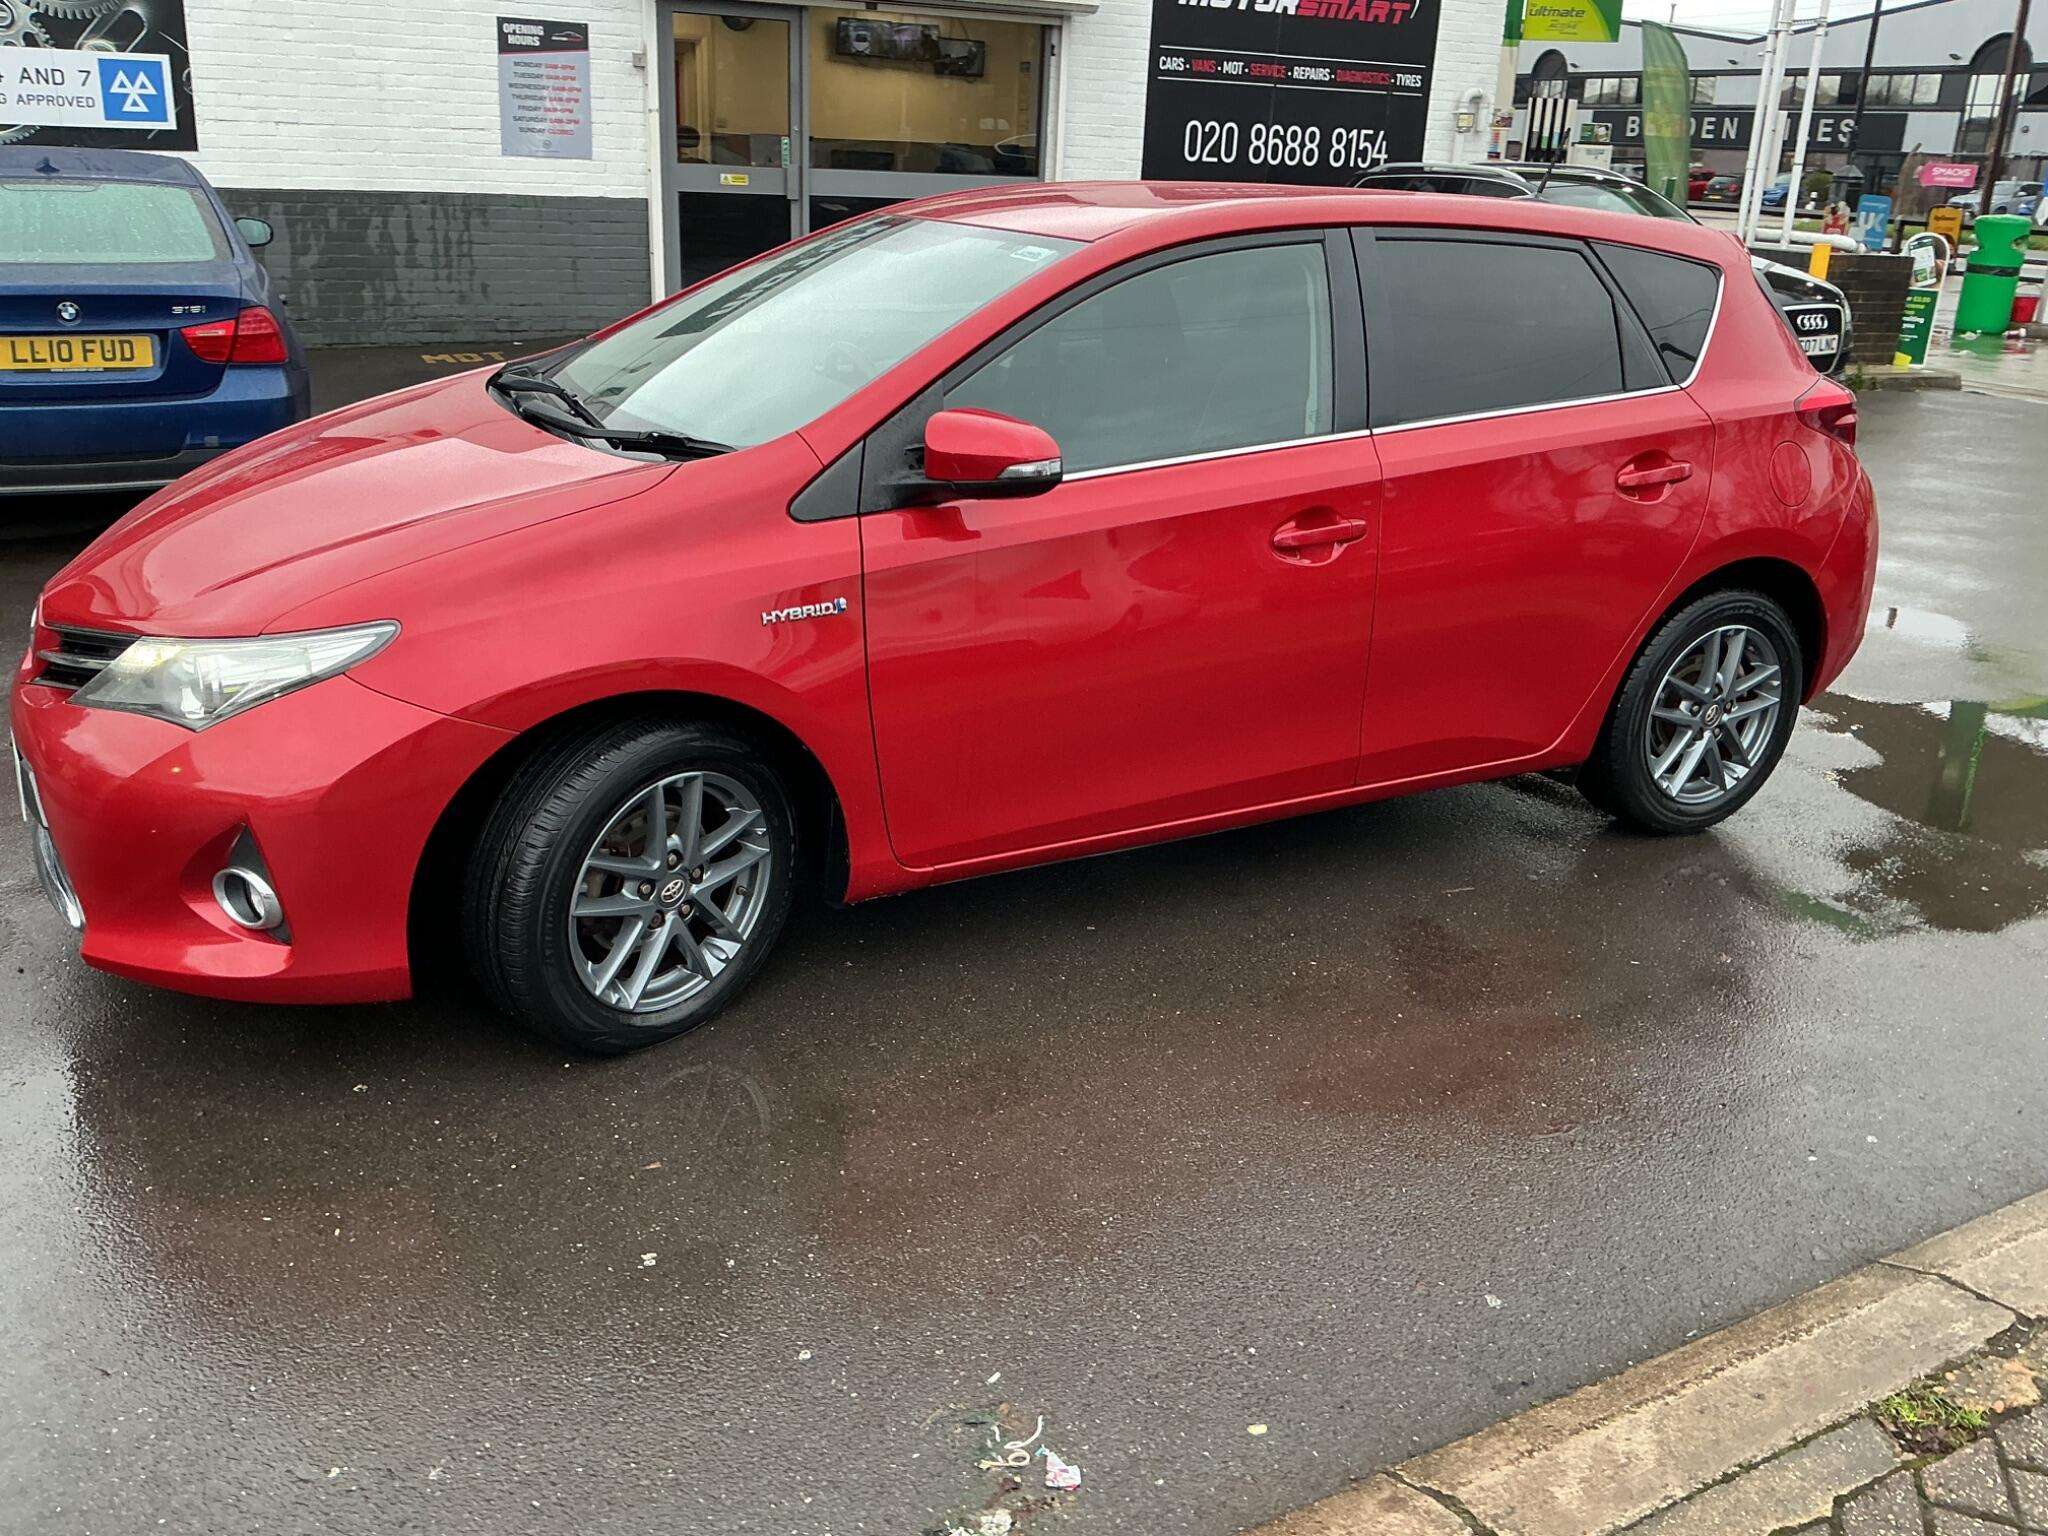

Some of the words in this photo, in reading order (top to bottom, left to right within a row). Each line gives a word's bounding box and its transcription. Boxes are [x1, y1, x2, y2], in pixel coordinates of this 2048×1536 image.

[503, 23, 544, 36] OPENING
[508, 34, 540, 46] HOURS
[19, 67, 65, 86] AND
[78, 70, 92, 87] 7
[1159, 56, 1184, 71] CARS
[1191, 59, 1216, 74] VANS
[1222, 61, 1244, 75] MOT
[1250, 63, 1287, 78] SERVICE
[1293, 66, 1330, 81] REPAIRS
[1336, 69, 1390, 85] DIAGNOSTICS
[1396, 73, 1422, 87] TYRES
[17, 94, 95, 108] APPROVED
[1626, 116, 1738, 139] BEN
[1184, 120, 1239, 163] 020
[1249, 123, 1320, 166] 8688
[1329, 127, 1388, 168] 8154
[10, 340, 72, 363] LL10
[82, 339, 135, 363] FUD
[421, 352, 505, 364] MOT
[762, 601, 836, 624] HYBRID
